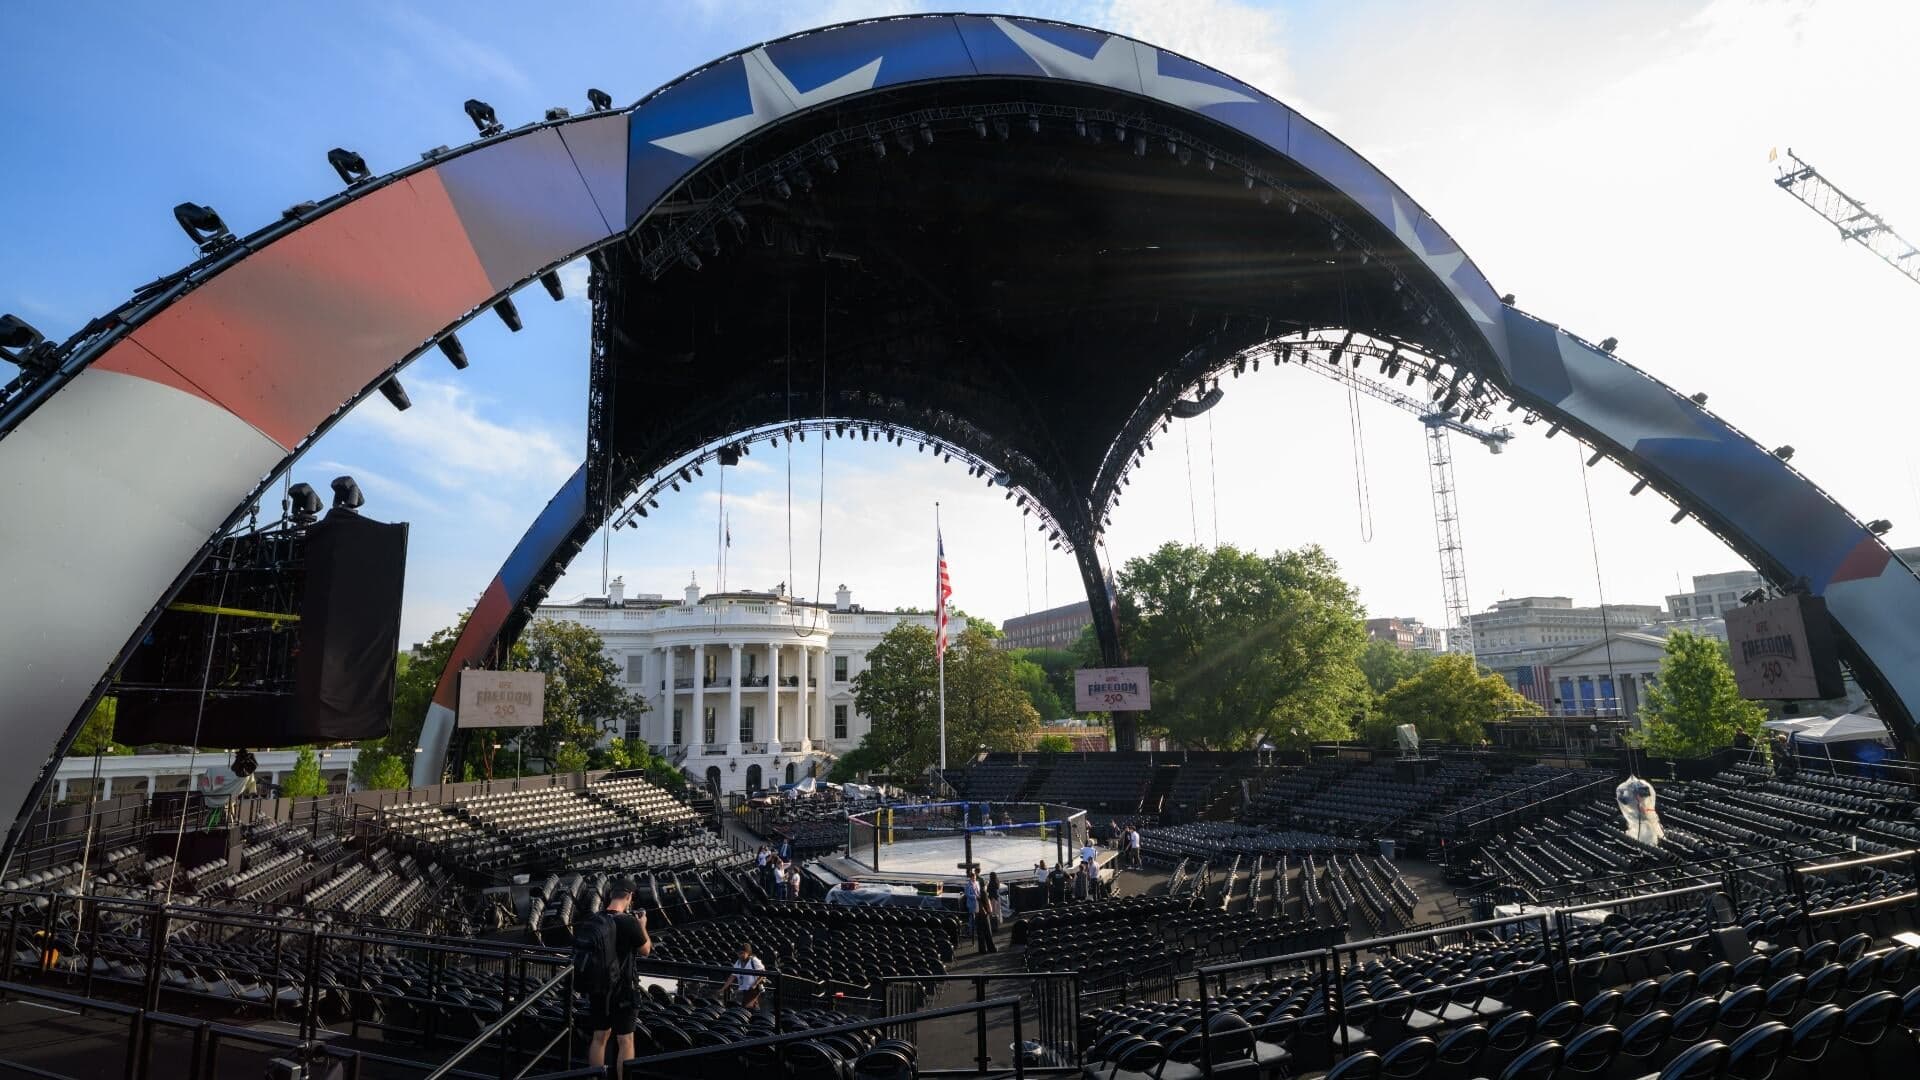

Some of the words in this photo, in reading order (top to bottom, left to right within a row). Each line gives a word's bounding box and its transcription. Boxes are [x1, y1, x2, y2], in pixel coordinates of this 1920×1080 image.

[1742, 633, 1796, 665] FREEDOM
[1761, 661, 1783, 684] 250
[1088, 682, 1137, 696] FREEDOM
[477, 689, 532, 706] FREEDOM
[1105, 694, 1123, 705] 250
[495, 704, 514, 717] 250
